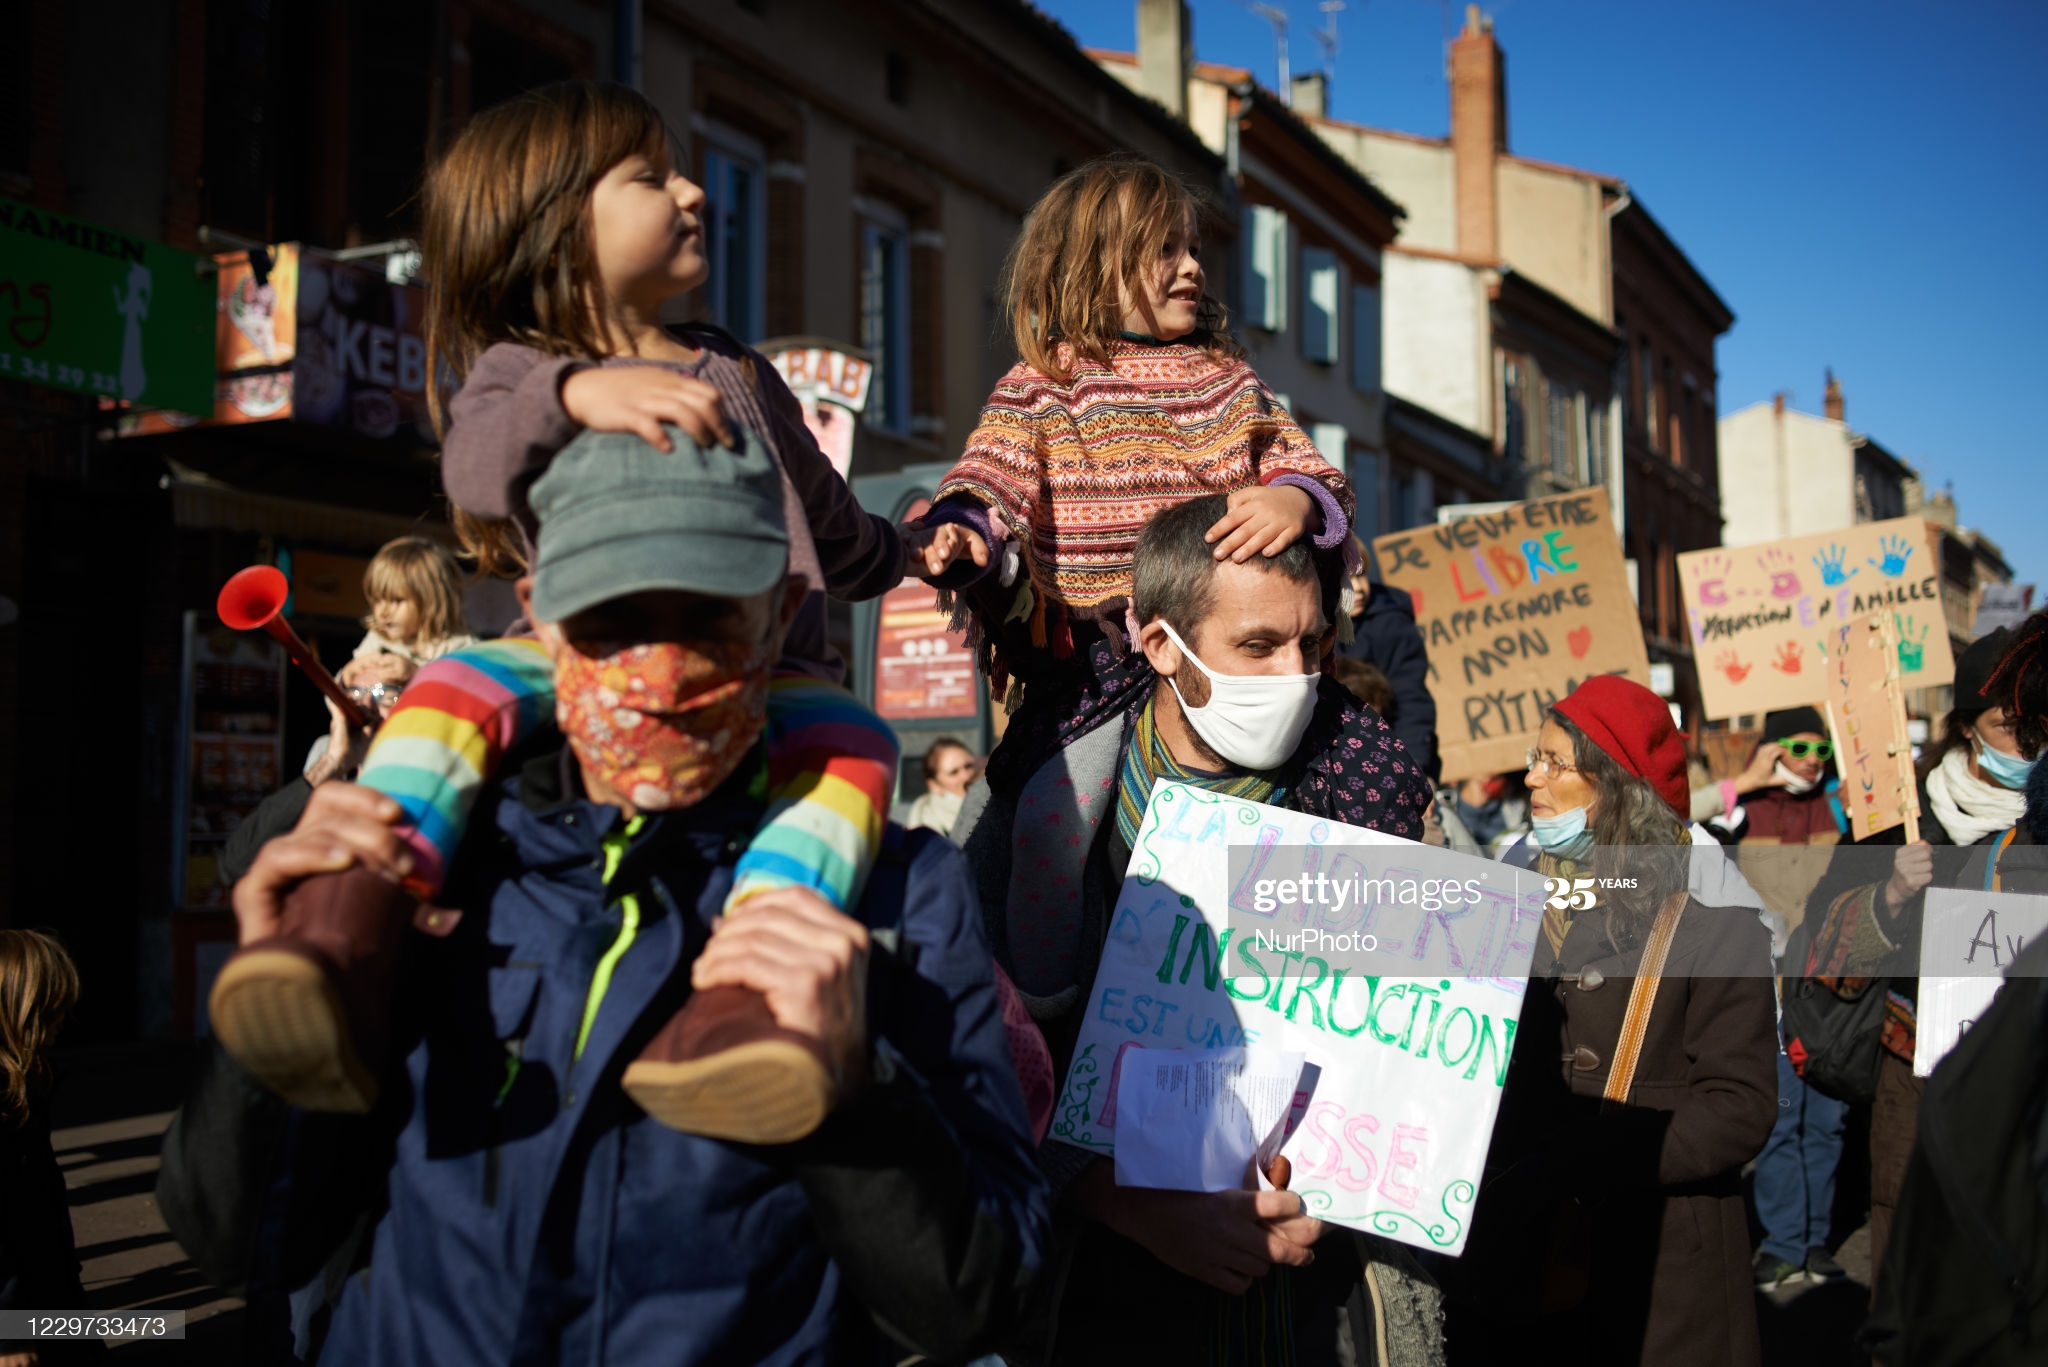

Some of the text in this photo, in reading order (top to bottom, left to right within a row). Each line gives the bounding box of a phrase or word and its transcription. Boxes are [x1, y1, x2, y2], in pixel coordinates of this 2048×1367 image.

[1449, 530, 1579, 603] LIBRE
[1462, 627, 1550, 686] MON
[1160, 796, 1228, 846] LA
[1099, 987, 1179, 1037] EST
